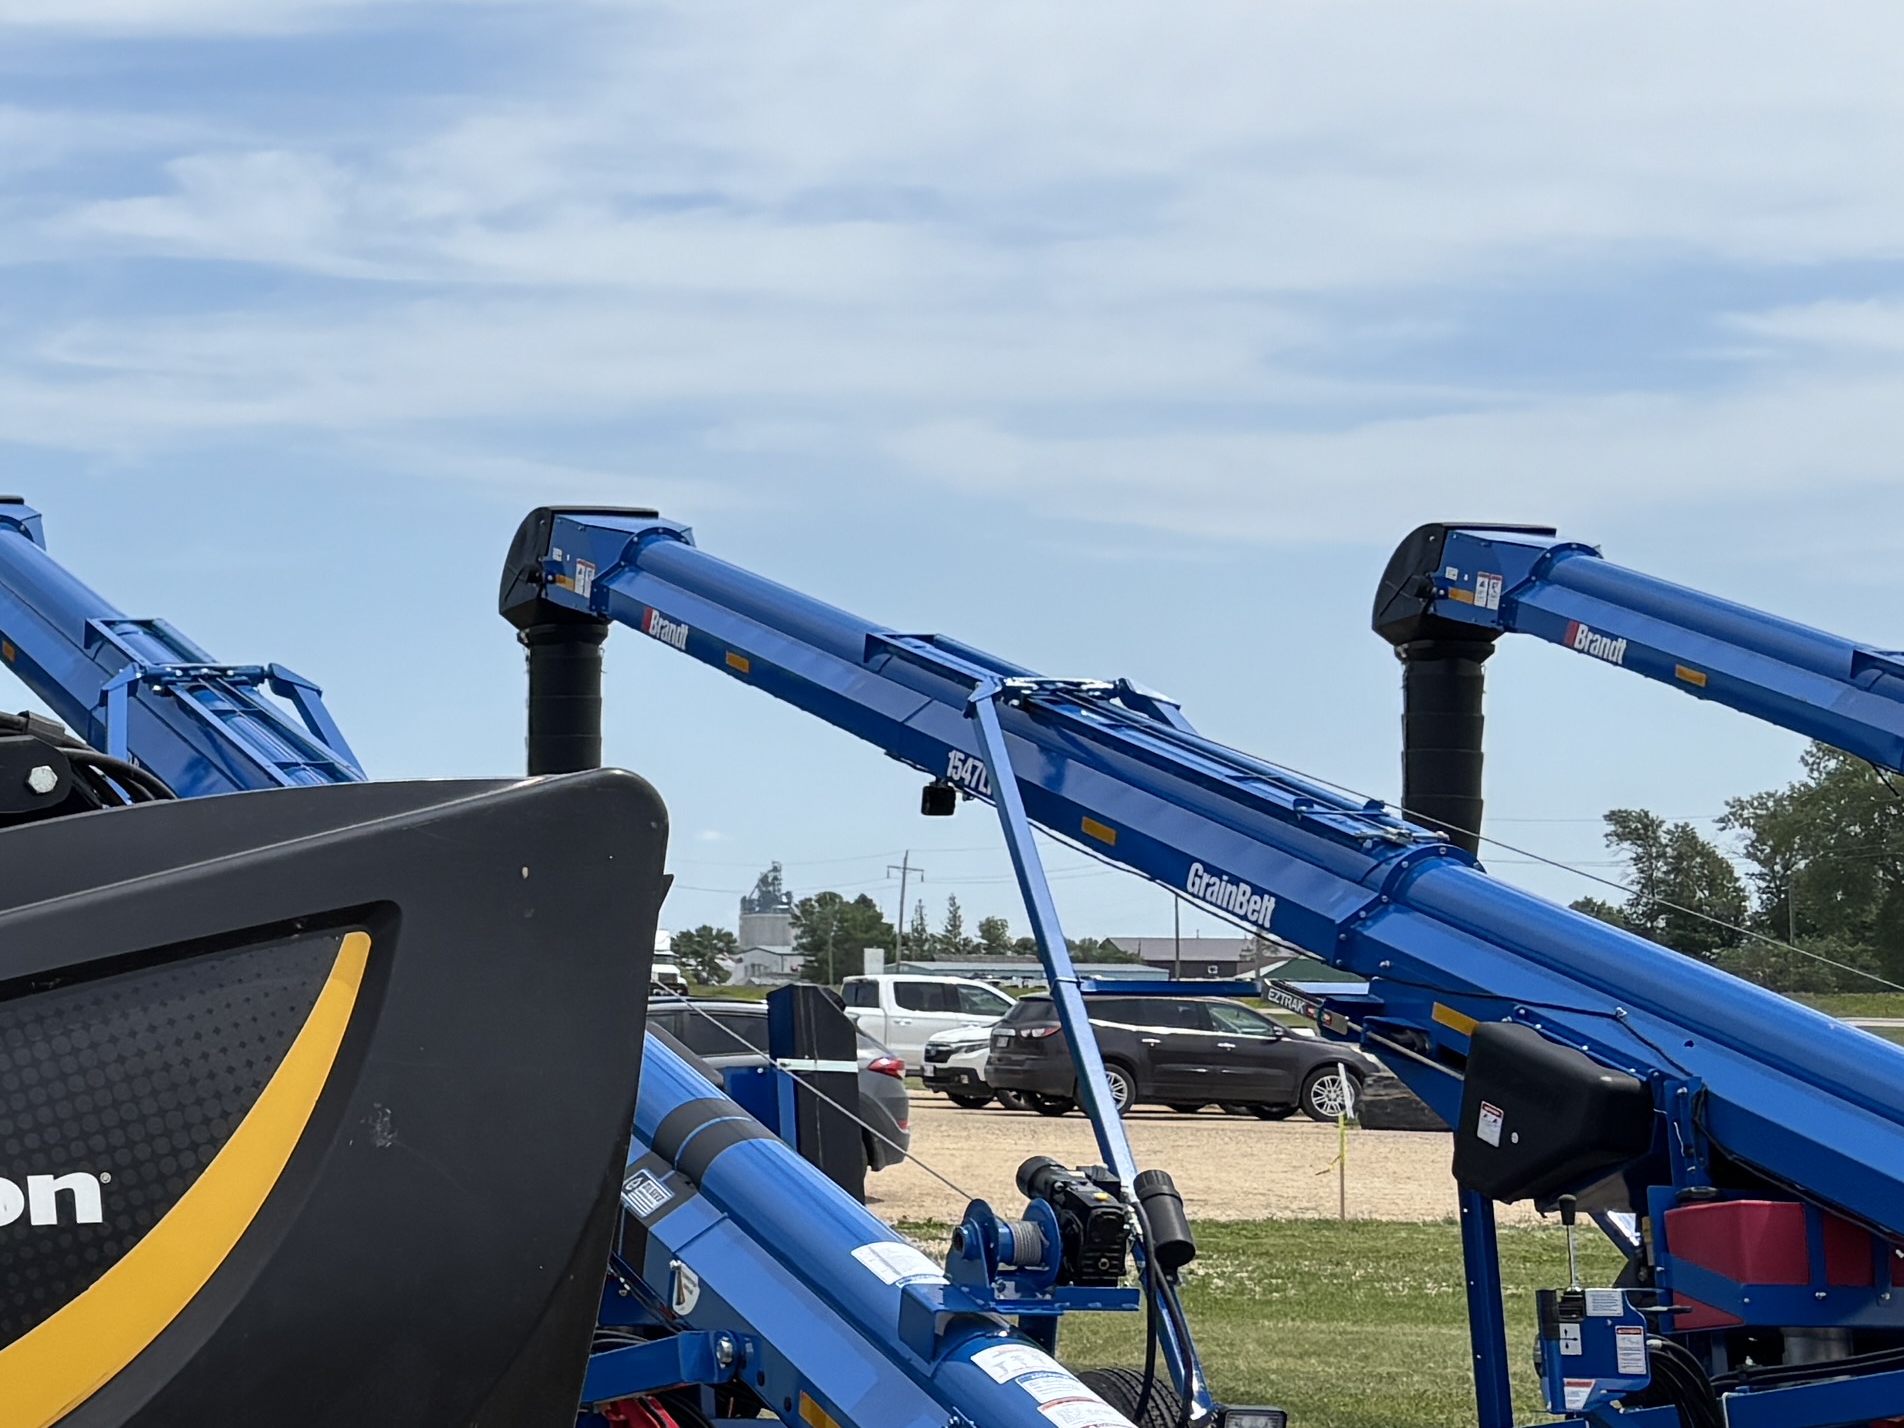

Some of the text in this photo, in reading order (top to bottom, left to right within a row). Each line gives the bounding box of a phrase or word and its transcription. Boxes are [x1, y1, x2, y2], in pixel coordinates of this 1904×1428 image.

[649, 608, 689, 651] Brandt
[1574, 623, 1627, 665] Brandt
[946, 749, 993, 796] 1547L
[1186, 861, 1277, 929] GrainBelt
[1267, 987, 1307, 1015] EZTRAK
